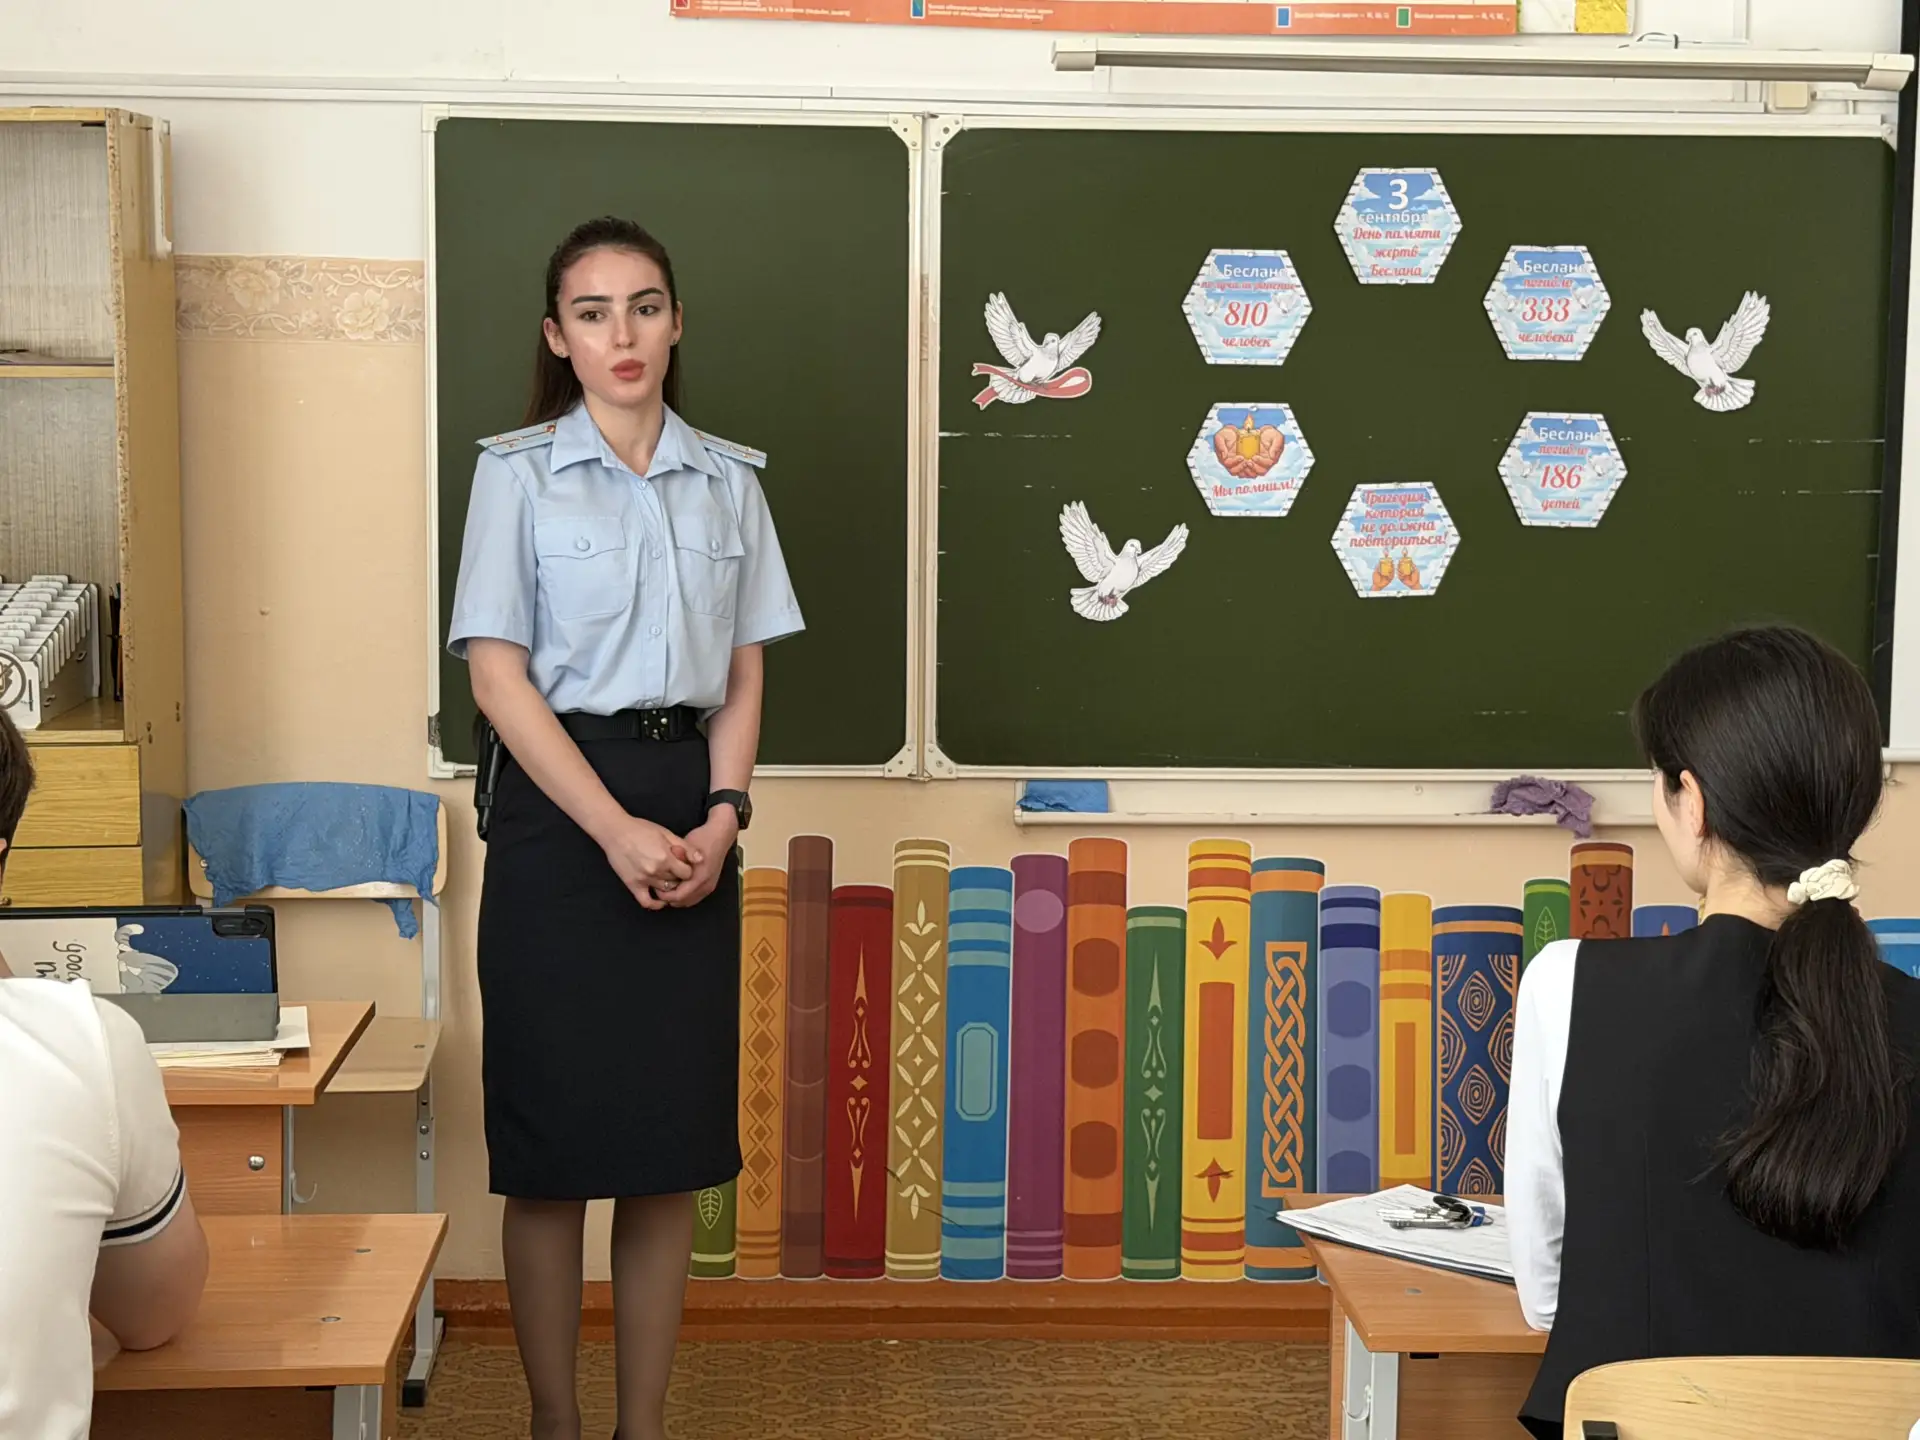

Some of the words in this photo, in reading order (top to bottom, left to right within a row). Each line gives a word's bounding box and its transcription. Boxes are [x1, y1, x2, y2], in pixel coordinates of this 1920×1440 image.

[1388, 178, 1409, 210] 3
[1353, 226, 1382, 240] День
[1385, 228, 1441, 240] памяти
[1374, 245, 1419, 260] жертв
[1370, 264, 1423, 277] Беслана
[1224, 301, 1269, 327] 810
[1521, 296, 1571, 322] 333
[1222, 335, 1272, 348] человек
[1518, 330, 1575, 343] человека
[1540, 463, 1584, 489] 186
[1212, 484, 1233, 497] Мы
[1235, 477, 1296, 495] помним!
[1541, 497, 1581, 512] детей
[1365, 507, 1425, 519] которая
[1360, 522, 1376, 533] не
[1379, 521, 1436, 535] должна
[1349, 531, 1449, 550] повториться!
